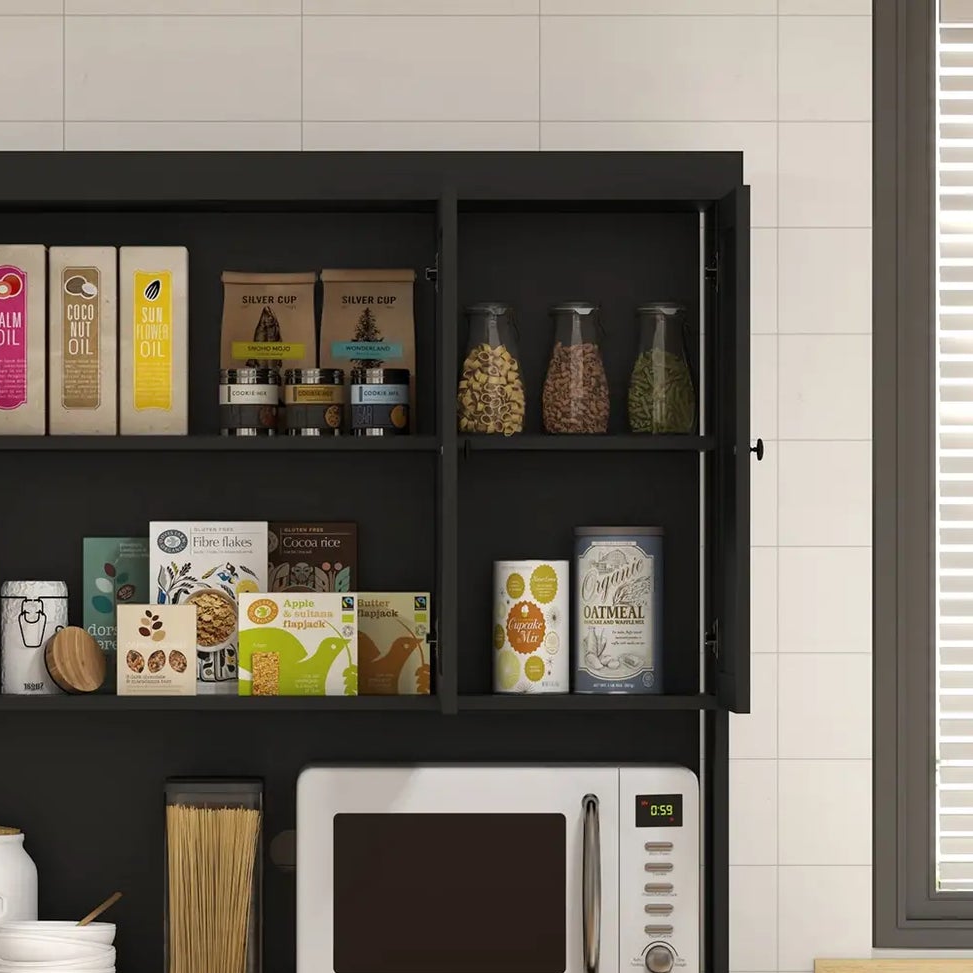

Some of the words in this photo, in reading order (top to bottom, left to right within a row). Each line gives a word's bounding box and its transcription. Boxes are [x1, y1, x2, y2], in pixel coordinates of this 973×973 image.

[242, 295, 274, 304] SILVER
[277, 295, 298, 304] CUP
[341, 295, 374, 304] SILVER
[376, 295, 397, 304] CUP
[67, 304, 94, 321] COCO
[141, 307, 163, 323] SUN
[70, 321, 91, 338] NUT
[136, 324, 169, 339] FLOWER
[68, 338, 94, 355] OIL
[140, 341, 165, 358] OIL
[193, 536, 220, 548] Fibre
[222, 536, 253, 548] flakes
[283, 537, 318, 548] Cocoa
[320, 537, 341, 548] rice
[581, 557, 644, 603] Organic
[283, 599, 315, 609] Apple
[357, 599, 391, 608] Butter
[283, 610, 292, 618] &
[294, 610, 334, 618] sultana
[357, 609, 399, 619] flapjack
[583, 605, 645, 619] OATMEAL
[283, 619, 326, 630] flapjack
[507, 617, 544, 632] Cupcake
[520, 630, 539, 643] Mix
[650, 804, 673, 816] 0:59
